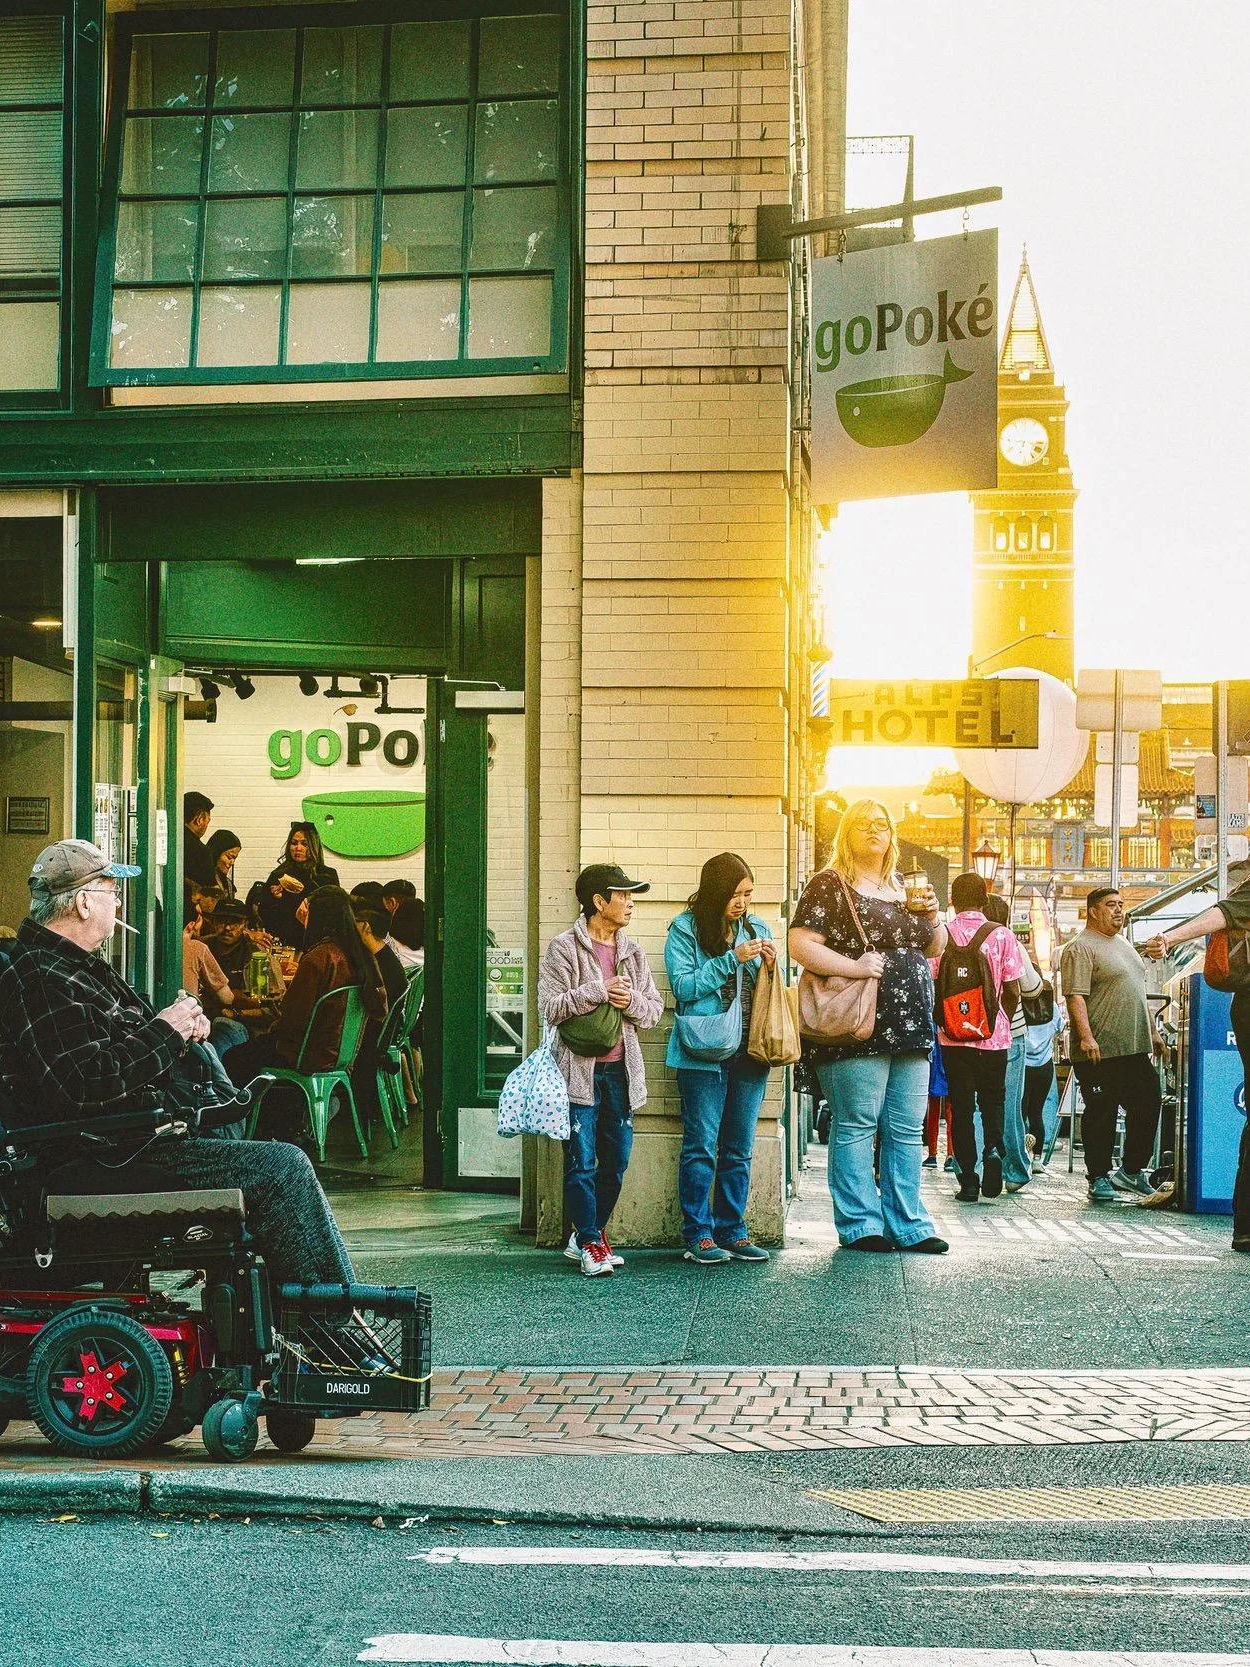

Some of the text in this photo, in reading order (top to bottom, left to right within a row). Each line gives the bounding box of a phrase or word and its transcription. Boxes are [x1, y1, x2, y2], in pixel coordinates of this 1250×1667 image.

[815, 283, 994, 373] goPoké
[874, 682, 983, 707] ALPS
[842, 709, 1014, 744] HOTEL
[268, 721, 496, 780] goPo
[326, 1382, 370, 1395] DARIGOLD
